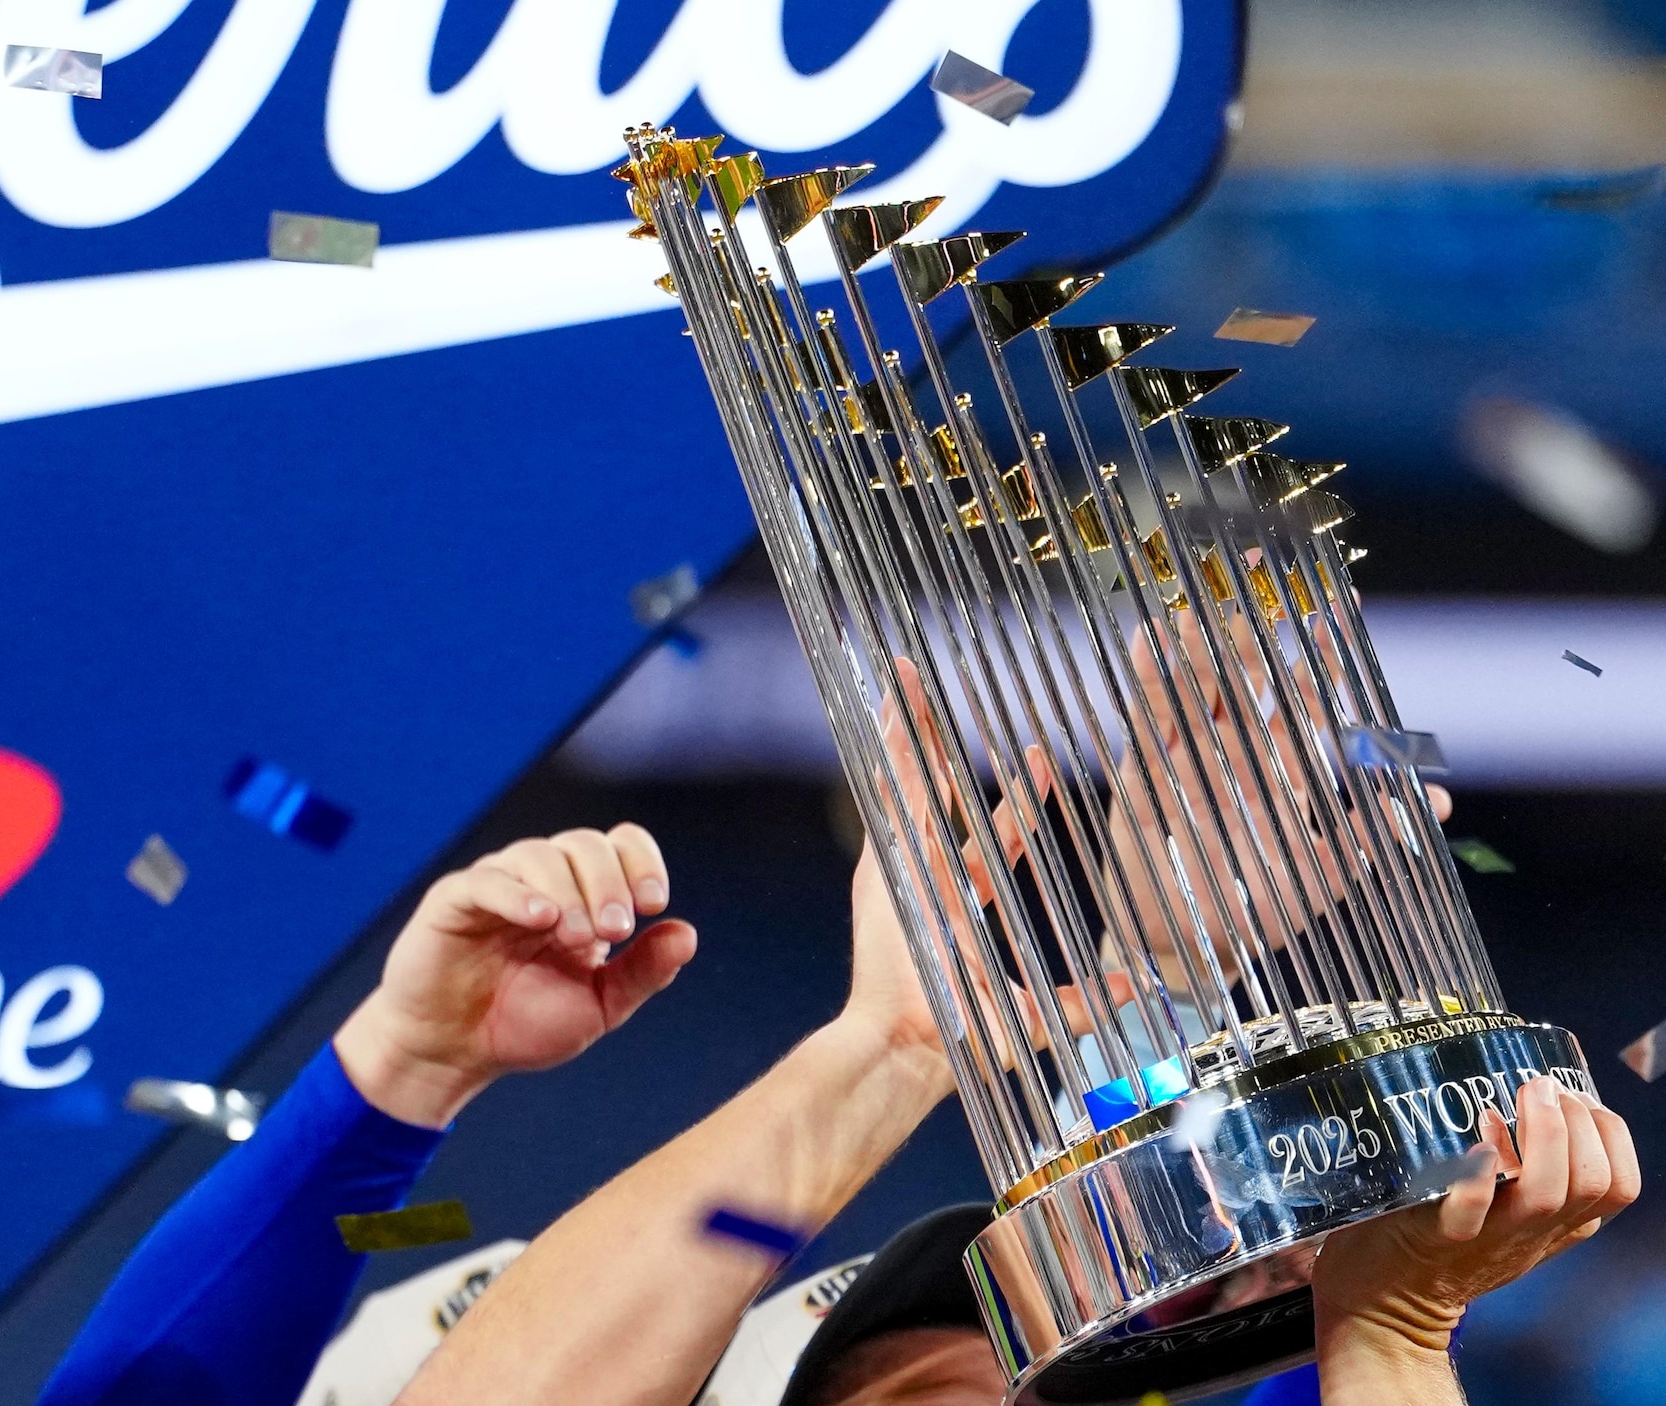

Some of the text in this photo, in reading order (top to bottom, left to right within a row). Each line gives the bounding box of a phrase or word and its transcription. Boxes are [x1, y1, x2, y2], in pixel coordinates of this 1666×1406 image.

[1376, 1015, 1486, 1052] PRESENTED
[1485, 1015, 1505, 1031] BY
[1268, 1106, 1382, 1189] 2025
